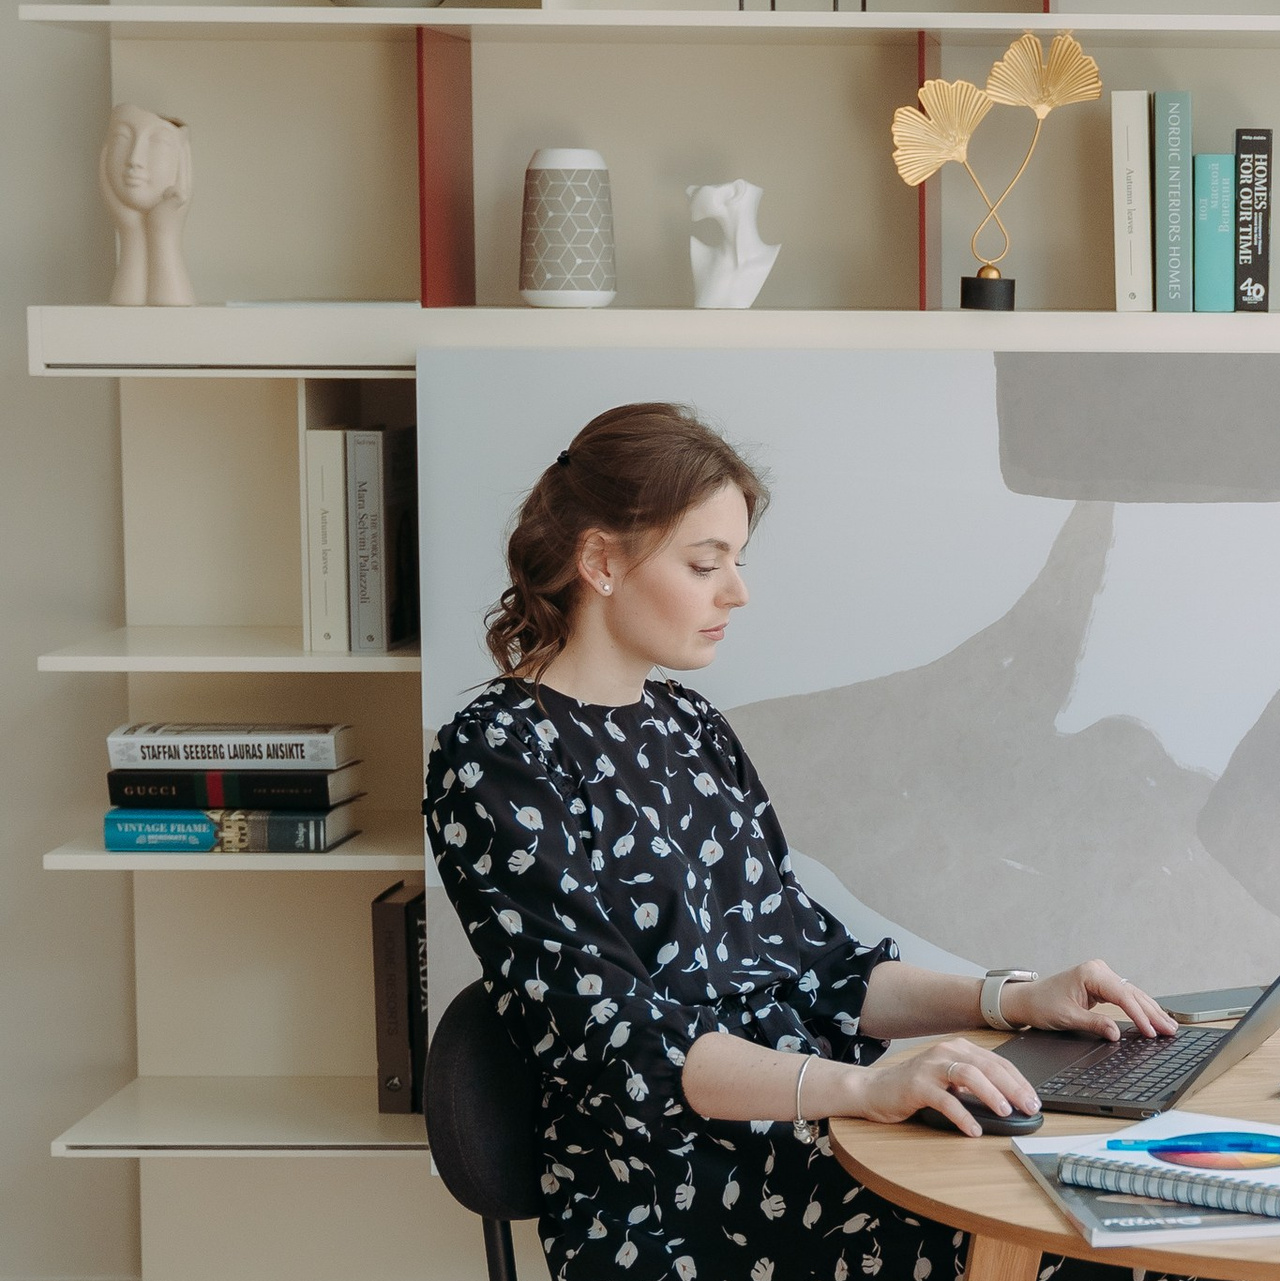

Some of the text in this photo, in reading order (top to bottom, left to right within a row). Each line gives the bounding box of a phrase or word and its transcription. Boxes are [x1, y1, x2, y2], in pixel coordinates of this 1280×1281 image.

[1168, 102, 1181, 300] NORDIC INTERIORS HOMES
[1255, 153, 1268, 210] HOMES
[1127, 207, 1136, 234] leaves
[1239, 153, 1253, 265] FOR OUR TIME
[357, 481, 371, 605] Mara Selvini Palazzoli
[140, 743, 306, 761] STAFFAN SEEBERG LAURAS ANSIKTE
[124, 786, 177, 796] GUCCI
[116, 822, 210, 833] VINTAGE FRAME
